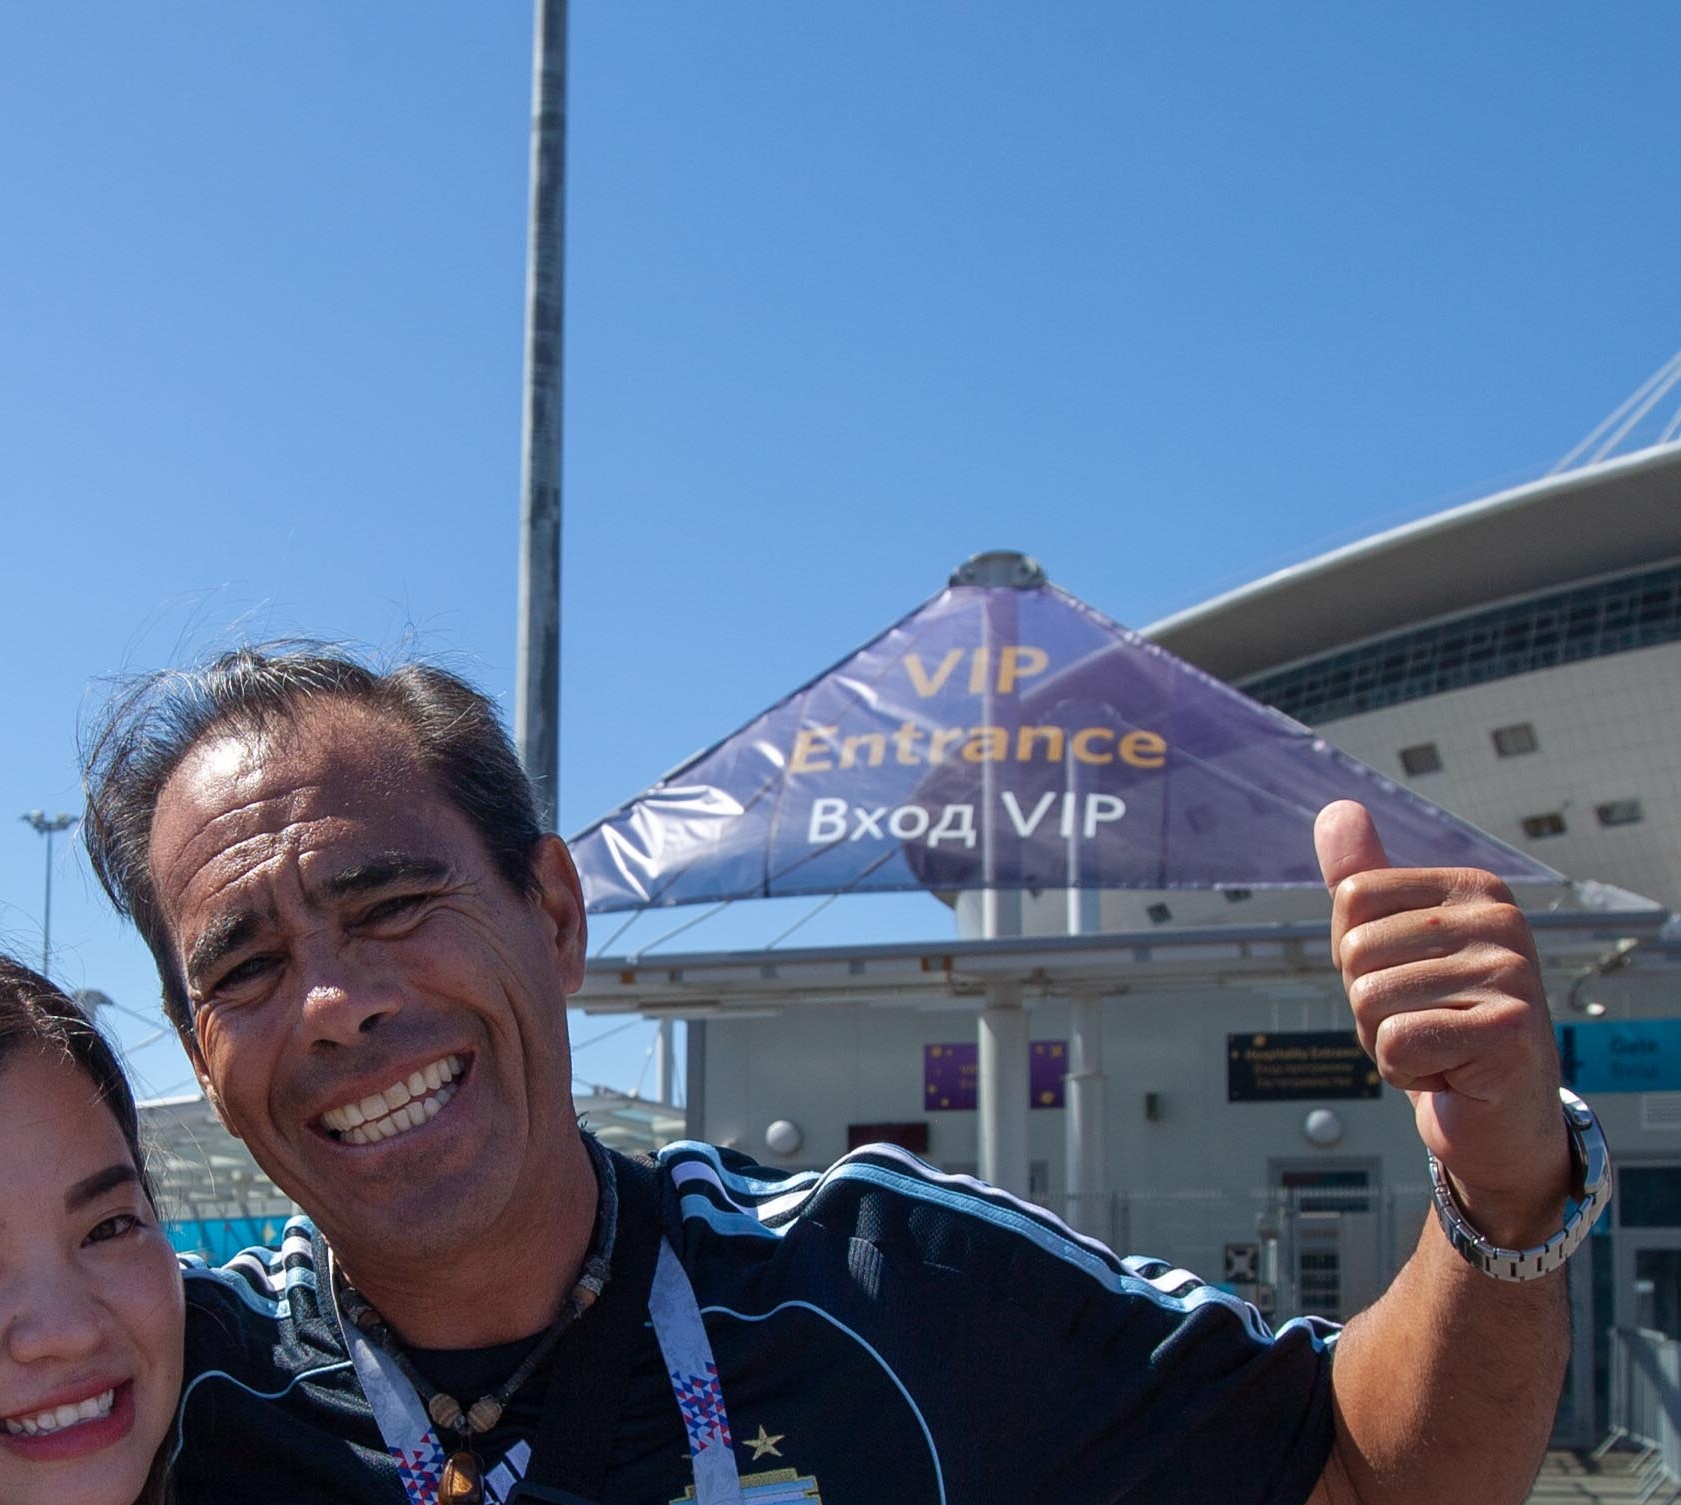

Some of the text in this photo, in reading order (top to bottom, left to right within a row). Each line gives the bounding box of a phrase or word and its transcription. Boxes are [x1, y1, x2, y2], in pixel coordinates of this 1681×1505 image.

[903, 645, 1049, 698] VIP
[789, 723, 1169, 775] Entrance
[807, 794, 1127, 848] Вход VIP
